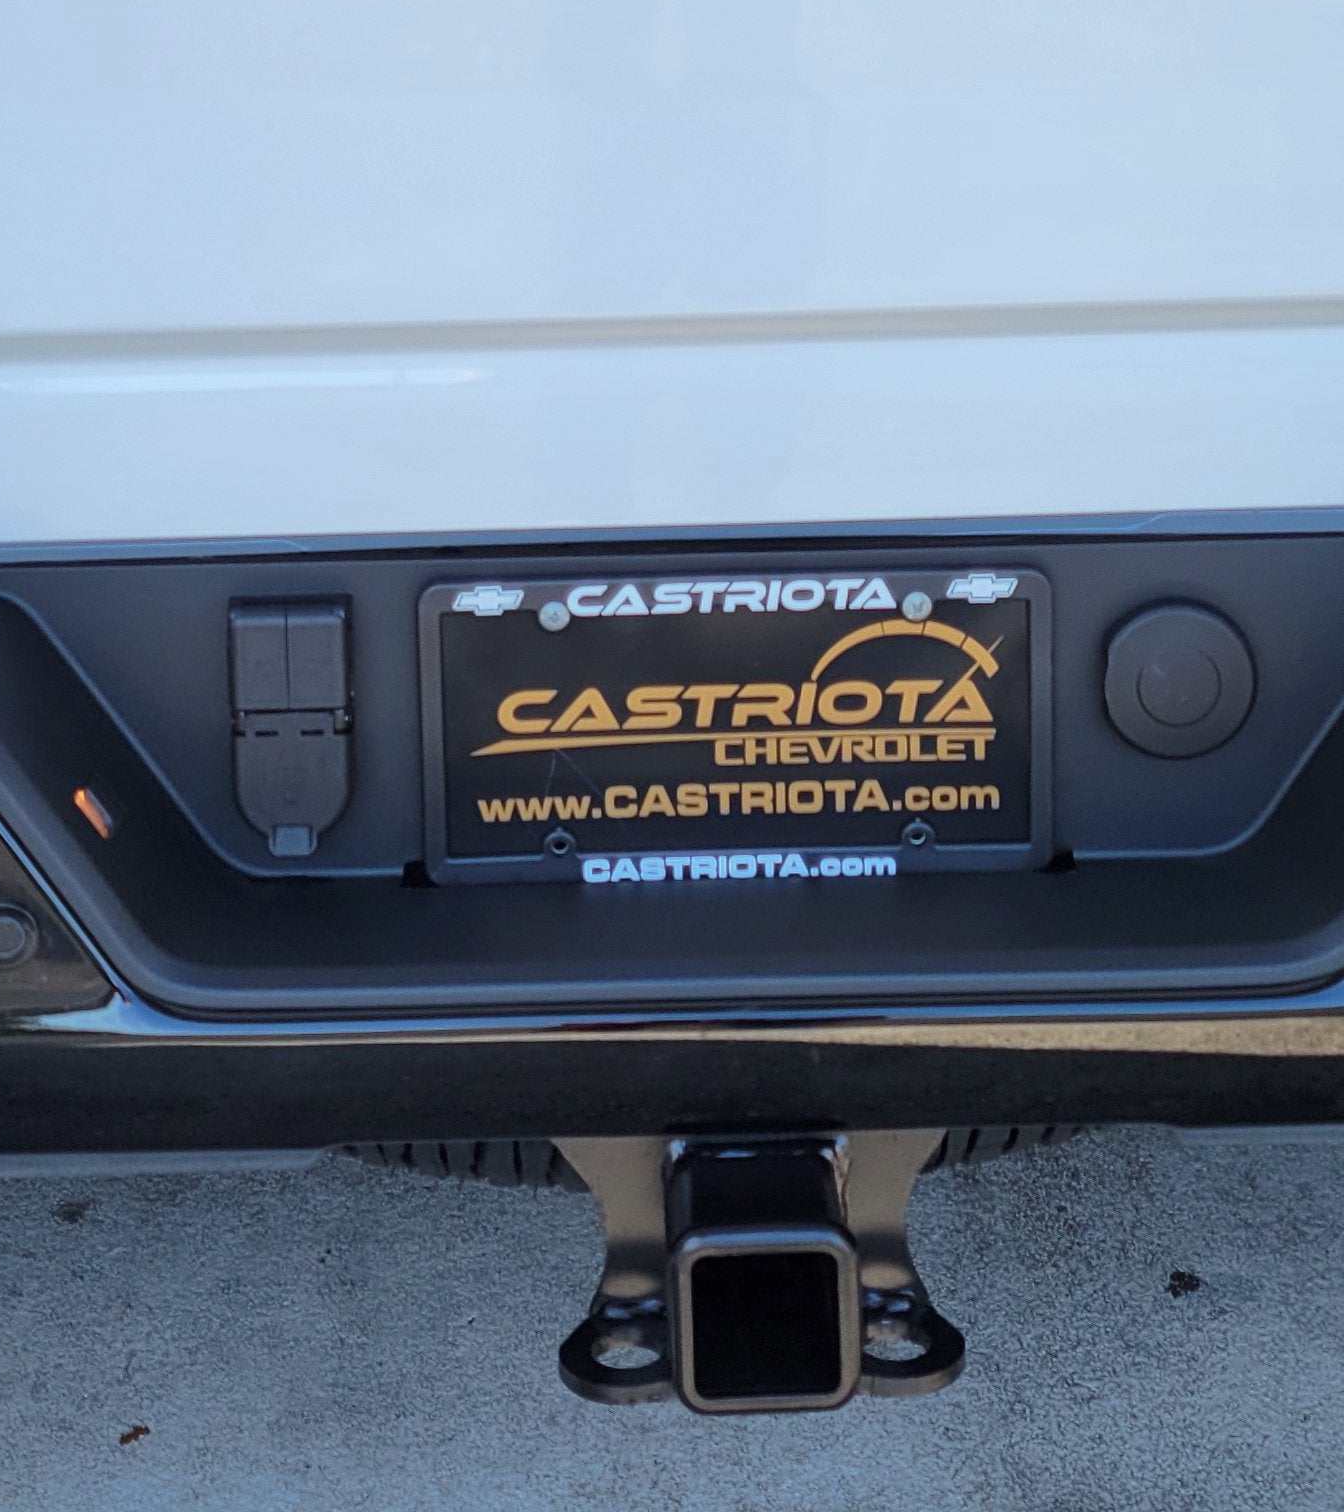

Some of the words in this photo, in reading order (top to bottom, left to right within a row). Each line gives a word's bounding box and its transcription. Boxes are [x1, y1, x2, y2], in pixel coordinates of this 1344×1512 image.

[565, 576, 898, 619] CASTRIOTA
[496, 679, 995, 734] CASTRIOTA
[714, 736, 992, 766] CHEVROLET
[477, 779, 1001, 824] www.CASTRIOTA.com
[582, 852, 898, 885] CASTRIOTA.com
